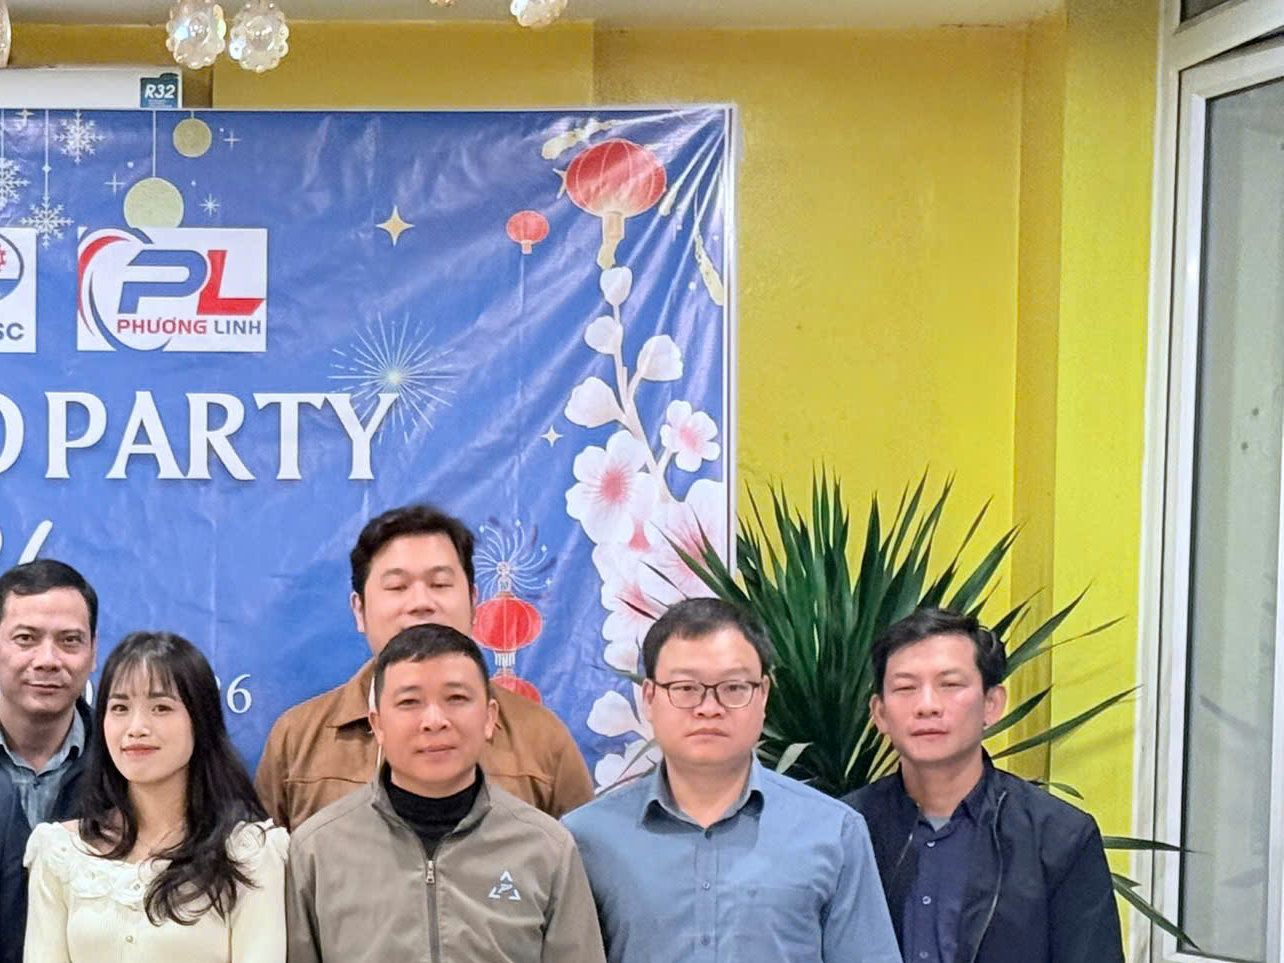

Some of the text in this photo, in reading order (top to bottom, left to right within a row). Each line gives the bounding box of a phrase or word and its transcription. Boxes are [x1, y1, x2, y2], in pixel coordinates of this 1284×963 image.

[144, 83, 176, 99] R32
[117, 249, 266, 316] PL
[117, 316, 261, 335] PHƯƠNG LINH
[44, 390, 400, 481] PARTY
